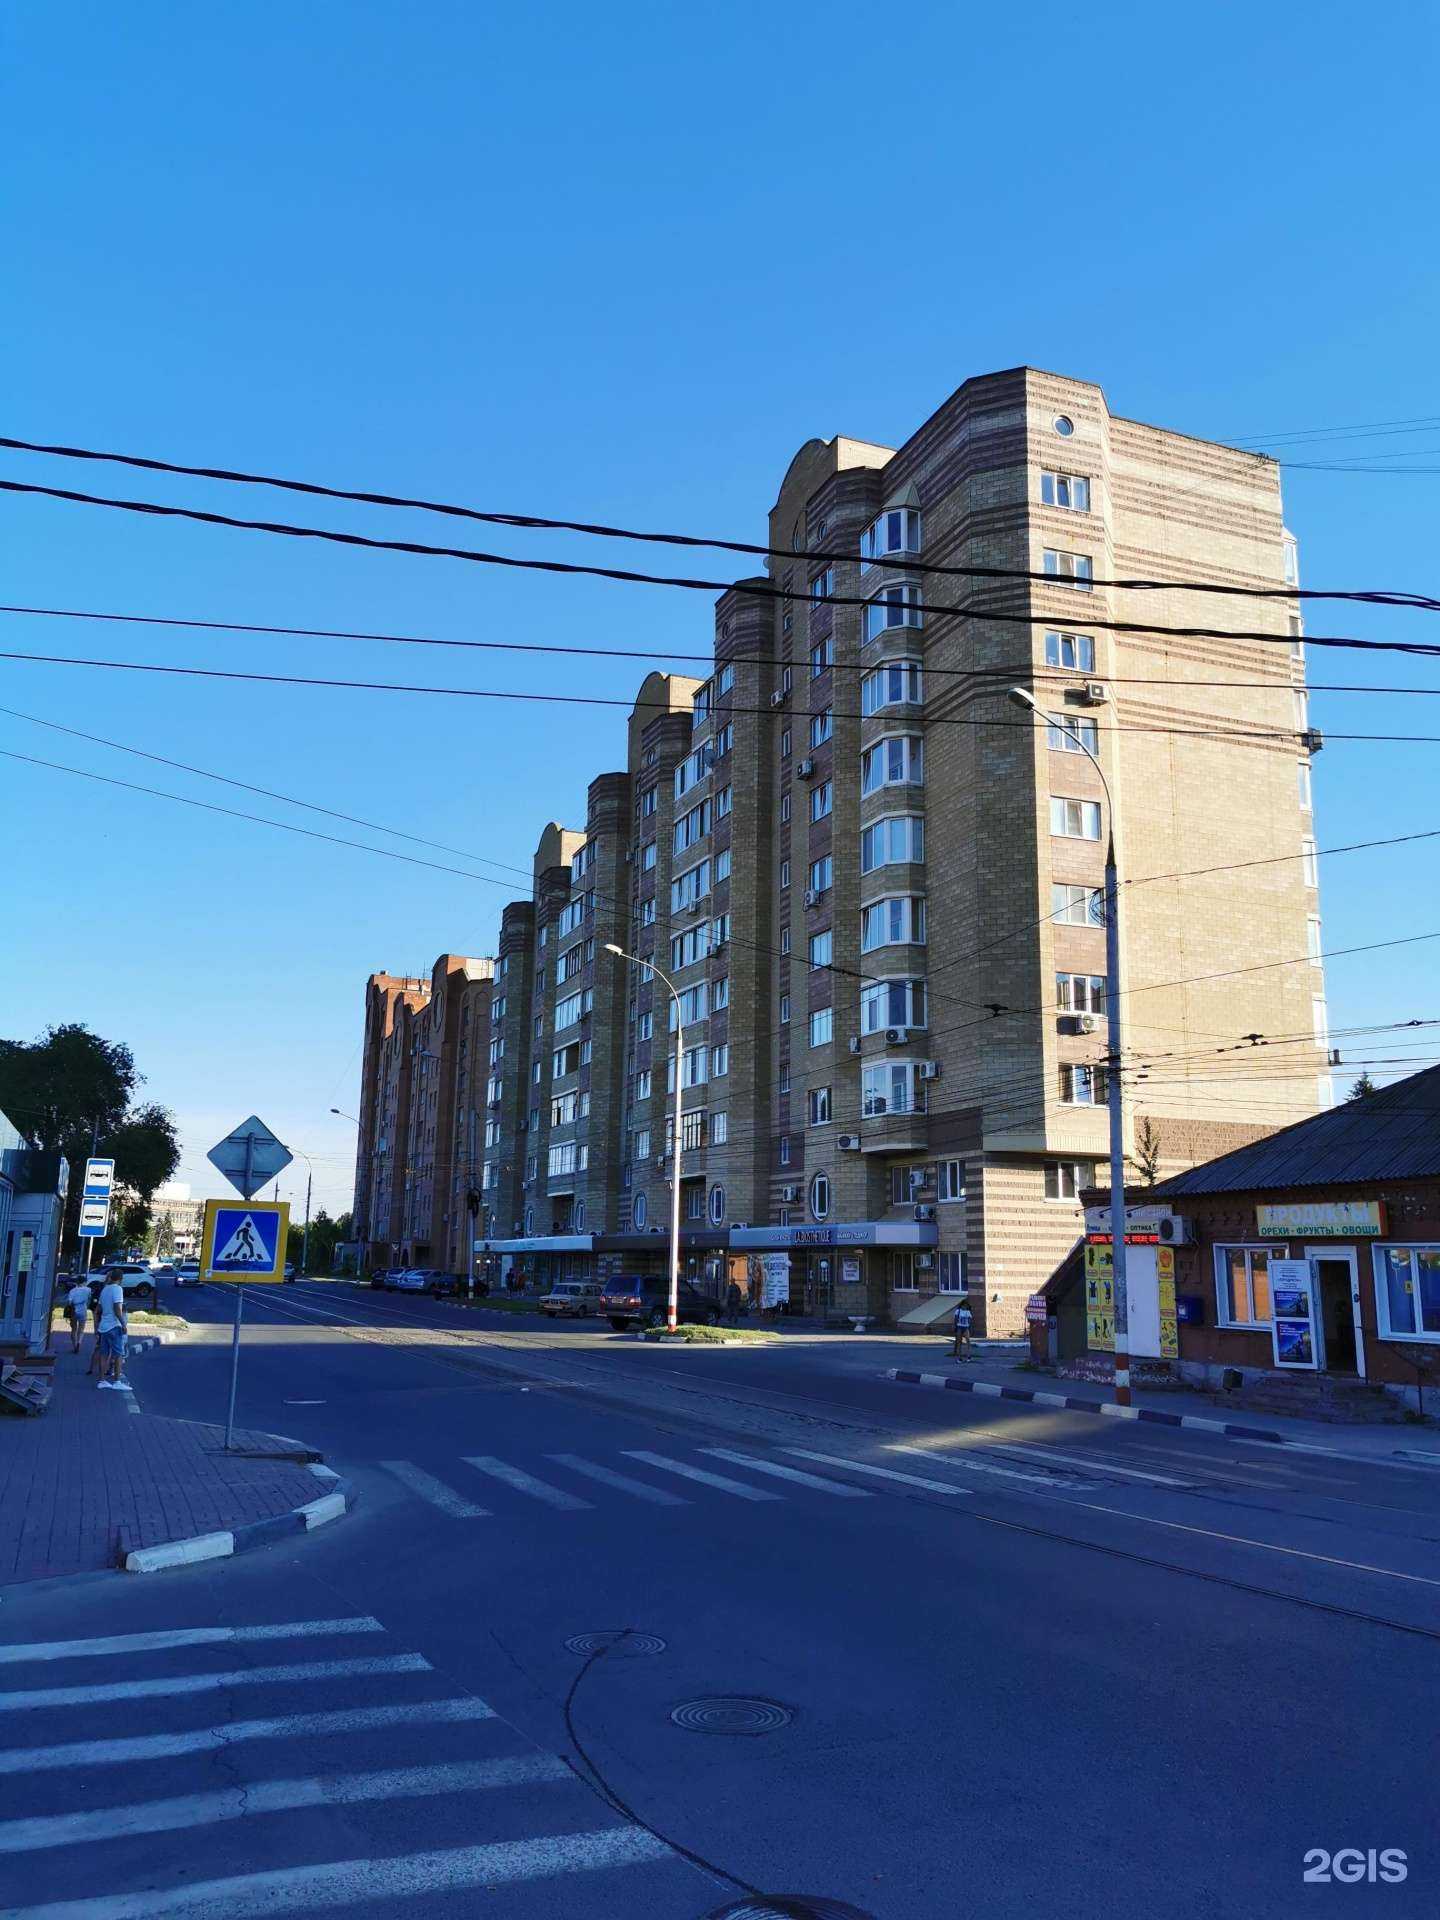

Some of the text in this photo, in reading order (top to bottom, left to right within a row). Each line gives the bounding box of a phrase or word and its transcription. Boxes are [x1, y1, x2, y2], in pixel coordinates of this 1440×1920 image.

[1264, 1202, 1370, 1225] ПРОДУКТЫ
[1130, 1224, 1153, 1232] ОПТИКА
[1261, 1225, 1379, 1235] ОРЕХИ ФРУКТЫ ОВОЩИ
